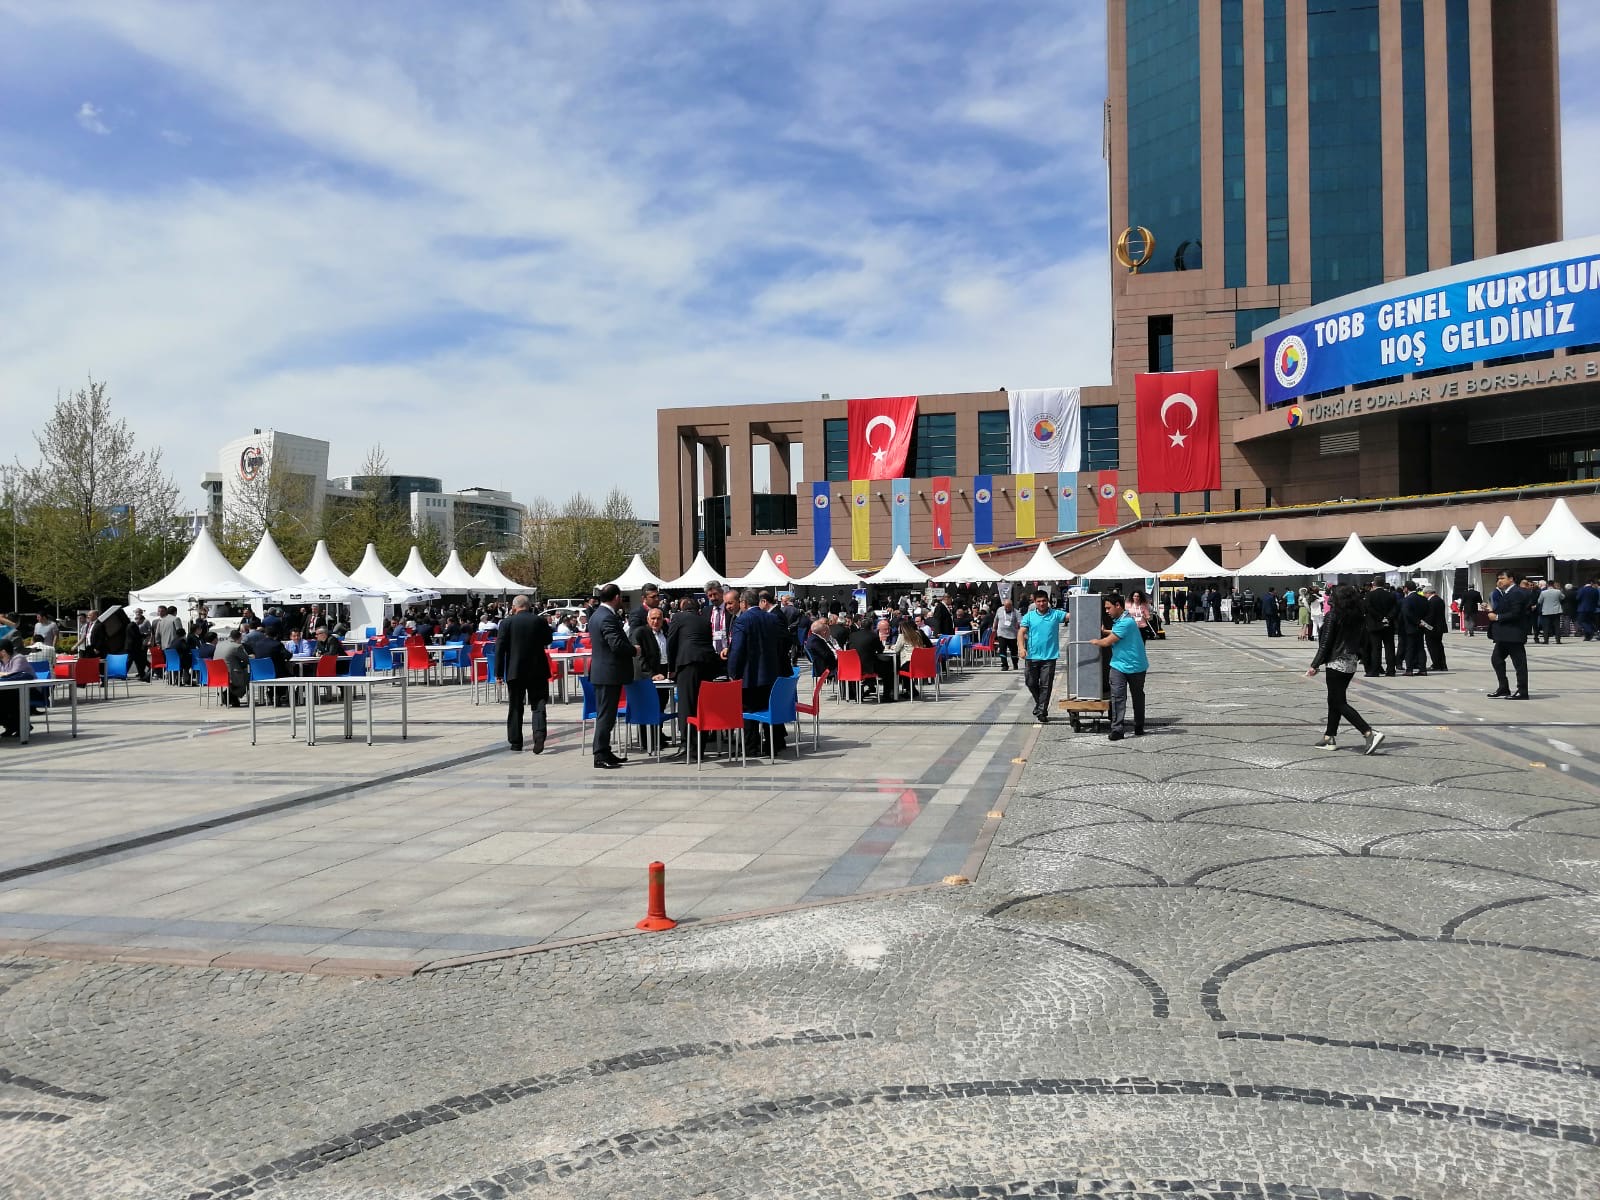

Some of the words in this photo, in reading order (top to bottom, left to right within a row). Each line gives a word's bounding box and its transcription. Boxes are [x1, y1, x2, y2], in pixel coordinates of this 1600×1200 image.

[1315, 312, 1365, 348] TOBB
[1378, 291, 1451, 331] GENEL
[1380, 330, 1426, 367] HOŞ
[1441, 300, 1575, 353] GELDİNİZ
[1308, 398, 1361, 420] TÜRKİYE
[1367, 386, 1431, 408] ODALAR
[1438, 381, 1459, 399] VE
[1466, 363, 1577, 392] BORSALAR
